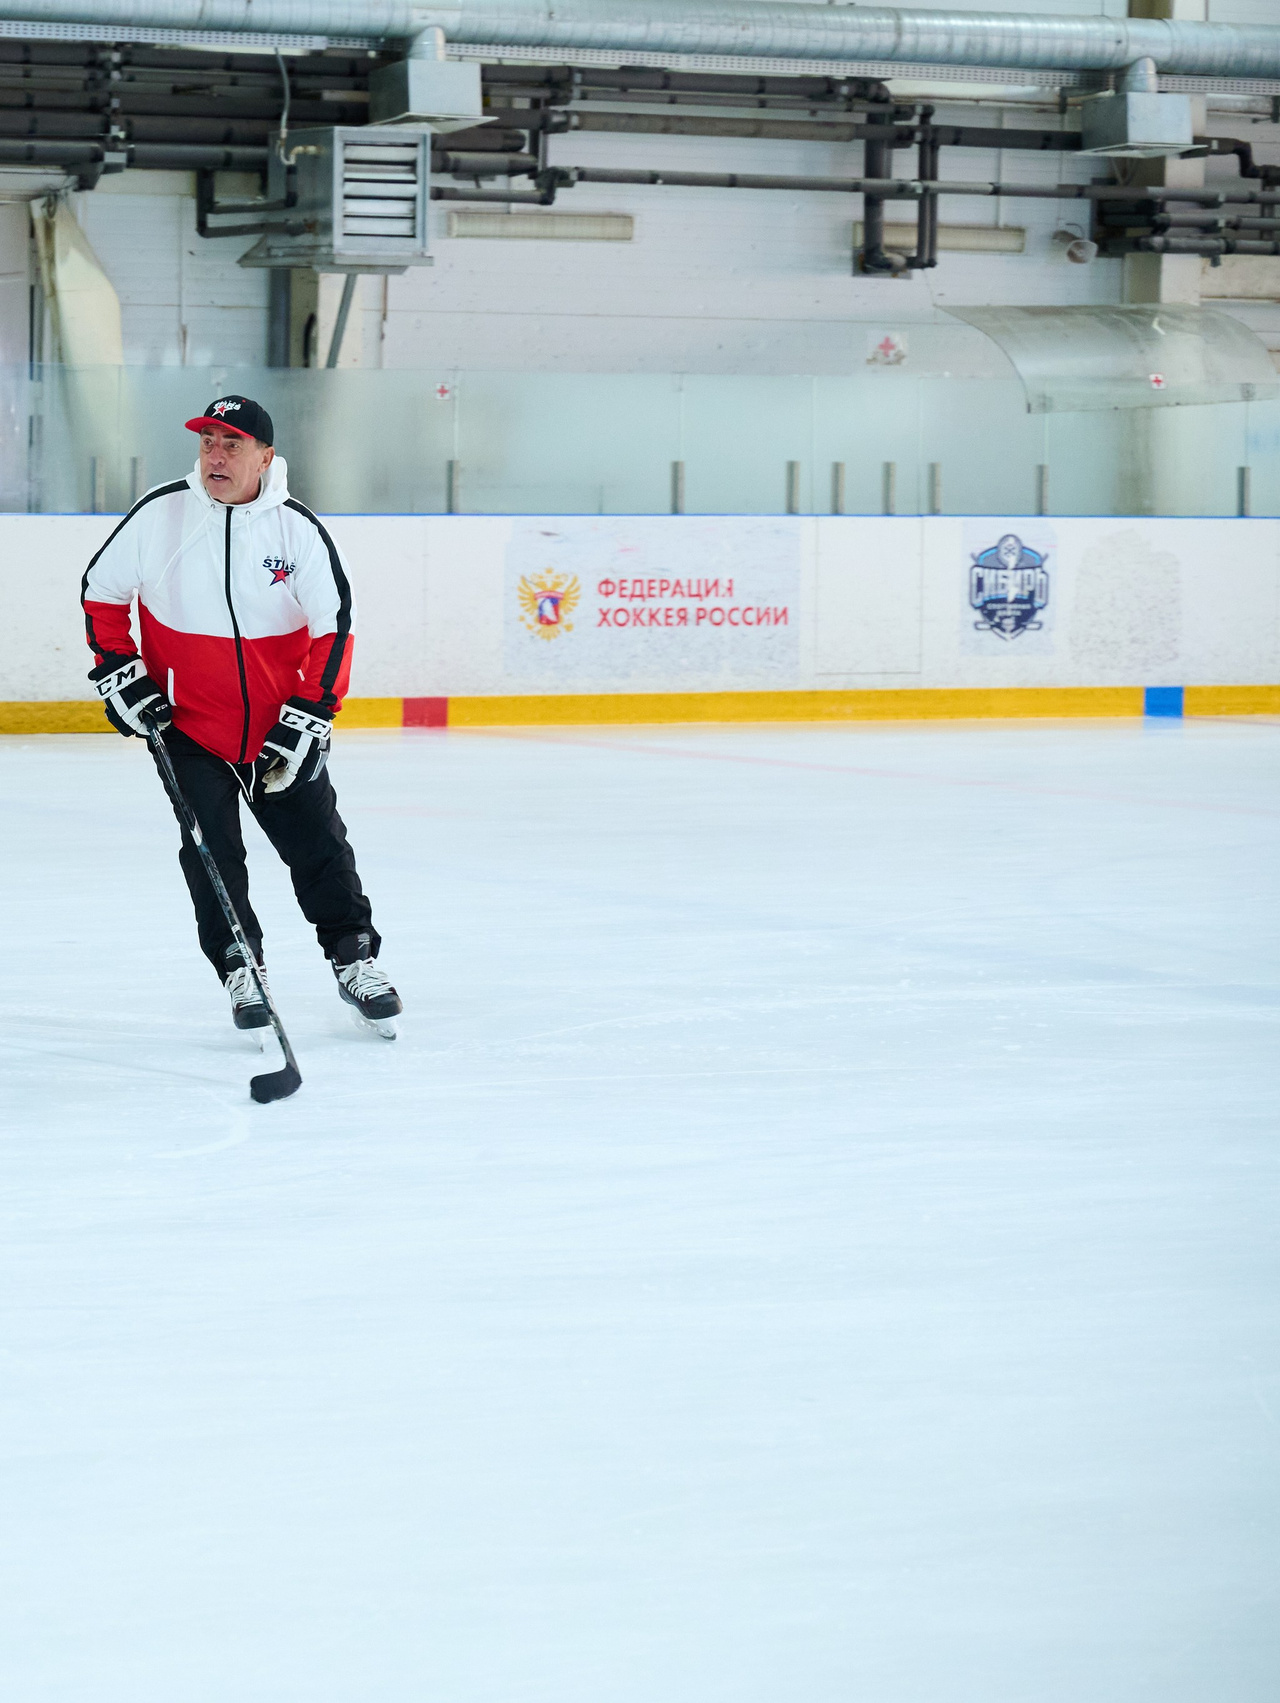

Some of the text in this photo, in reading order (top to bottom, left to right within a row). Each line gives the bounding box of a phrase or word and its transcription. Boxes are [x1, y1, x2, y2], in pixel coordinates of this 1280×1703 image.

[597, 606, 790, 628] ХОККЕЯ РОССИИ
[94, 664, 136, 697] CM
[281, 711, 332, 738] CC
